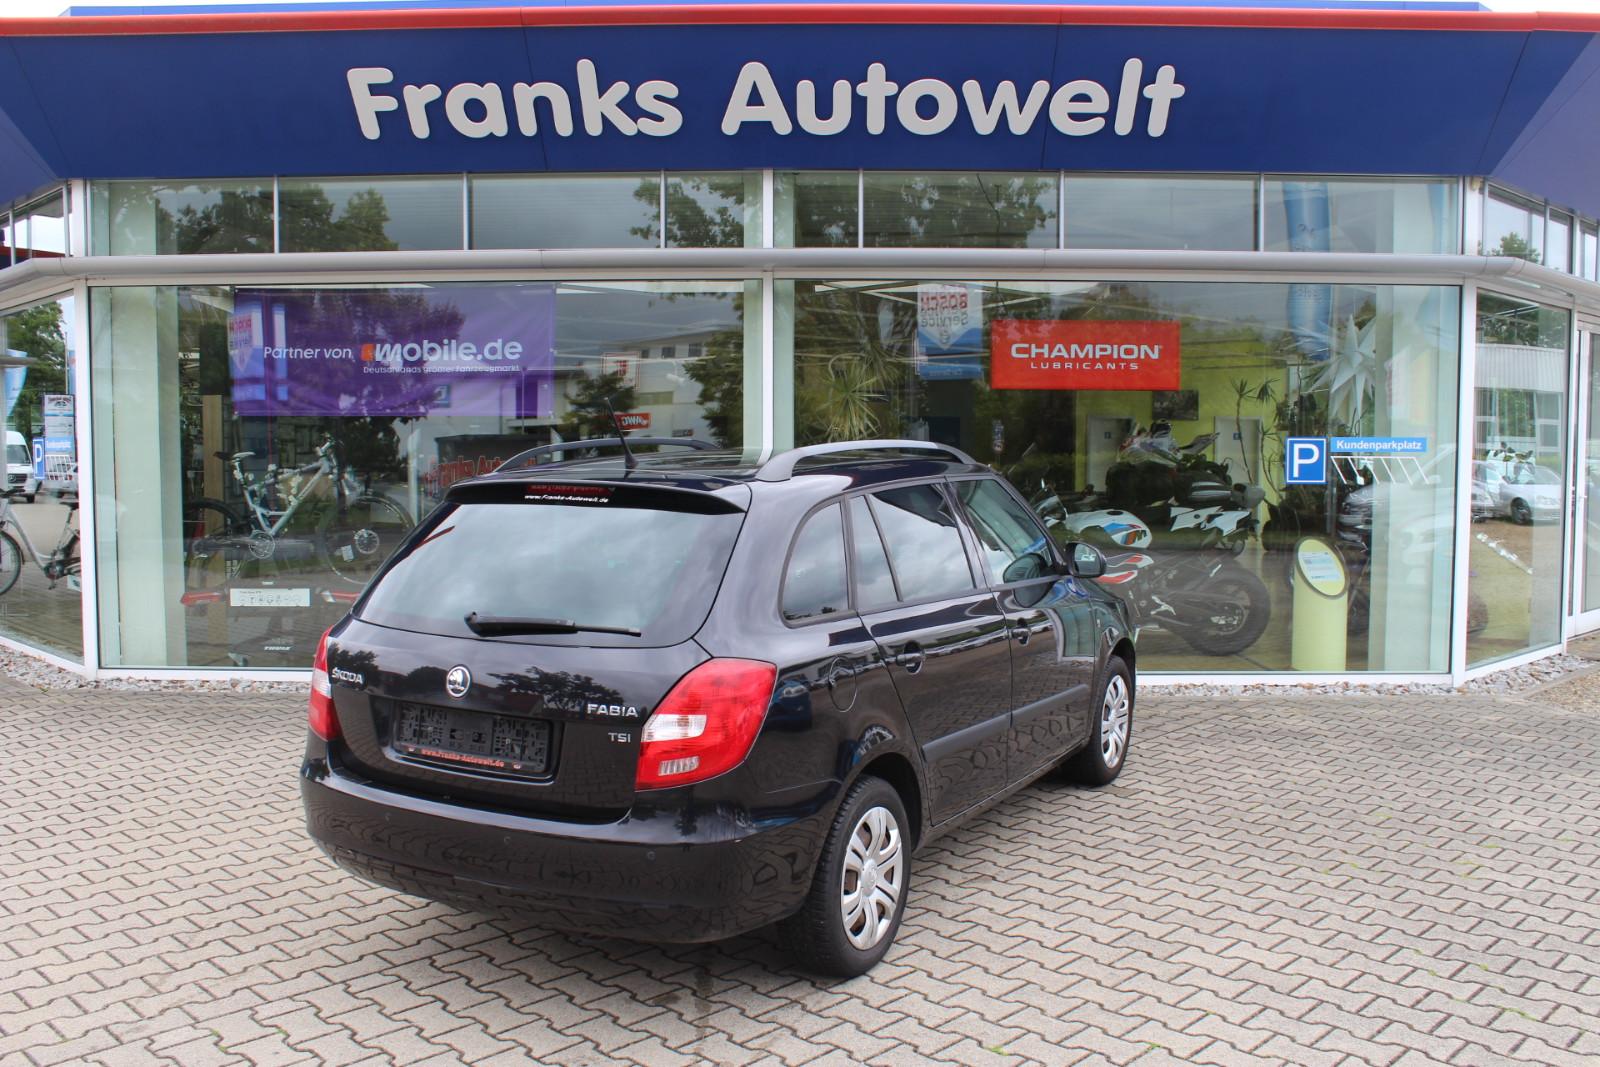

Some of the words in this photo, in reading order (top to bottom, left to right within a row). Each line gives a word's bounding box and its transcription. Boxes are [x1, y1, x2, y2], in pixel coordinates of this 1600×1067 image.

[346, 58, 682, 140] Franks
[720, 57, 1186, 138] Autowelt
[263, 346, 321, 360] Partner
[325, 349, 352, 360] von
[374, 338, 523, 363] mobile.de
[1010, 343, 1160, 360] CHAMPION
[1030, 362, 1139, 371] LUBRICANTS
[1336, 439, 1423, 452] Kundenparkplatz
[1293, 443, 1320, 478] P
[587, 703, 639, 718] FABIA
[608, 732, 631, 743] TSI
